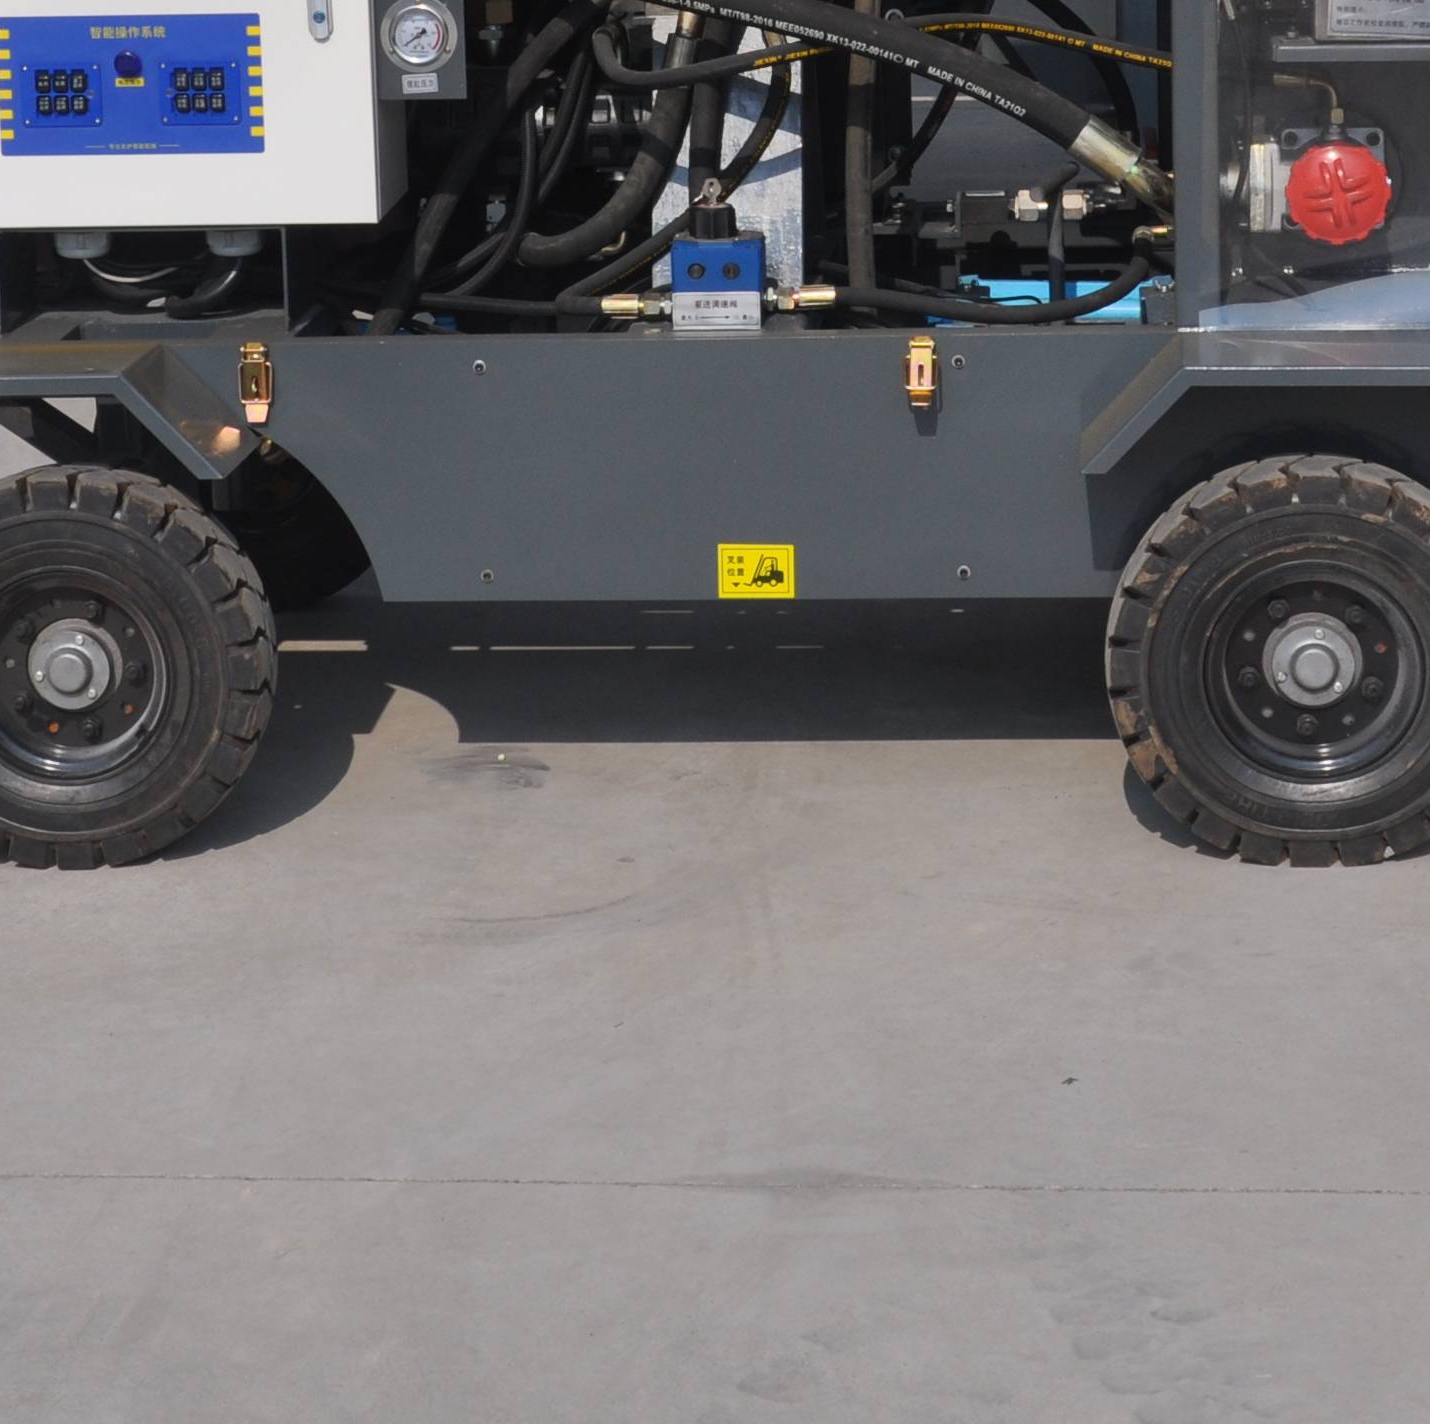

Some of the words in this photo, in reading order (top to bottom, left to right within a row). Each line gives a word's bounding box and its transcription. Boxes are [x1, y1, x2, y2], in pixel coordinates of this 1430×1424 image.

[90, 26, 167, 39] 智能操作系统
[927, 66, 954, 83] MADE
[954, 75, 965, 87] IN
[965, 81, 992, 100] CHINA
[727, 568, 745, 576] 位置
